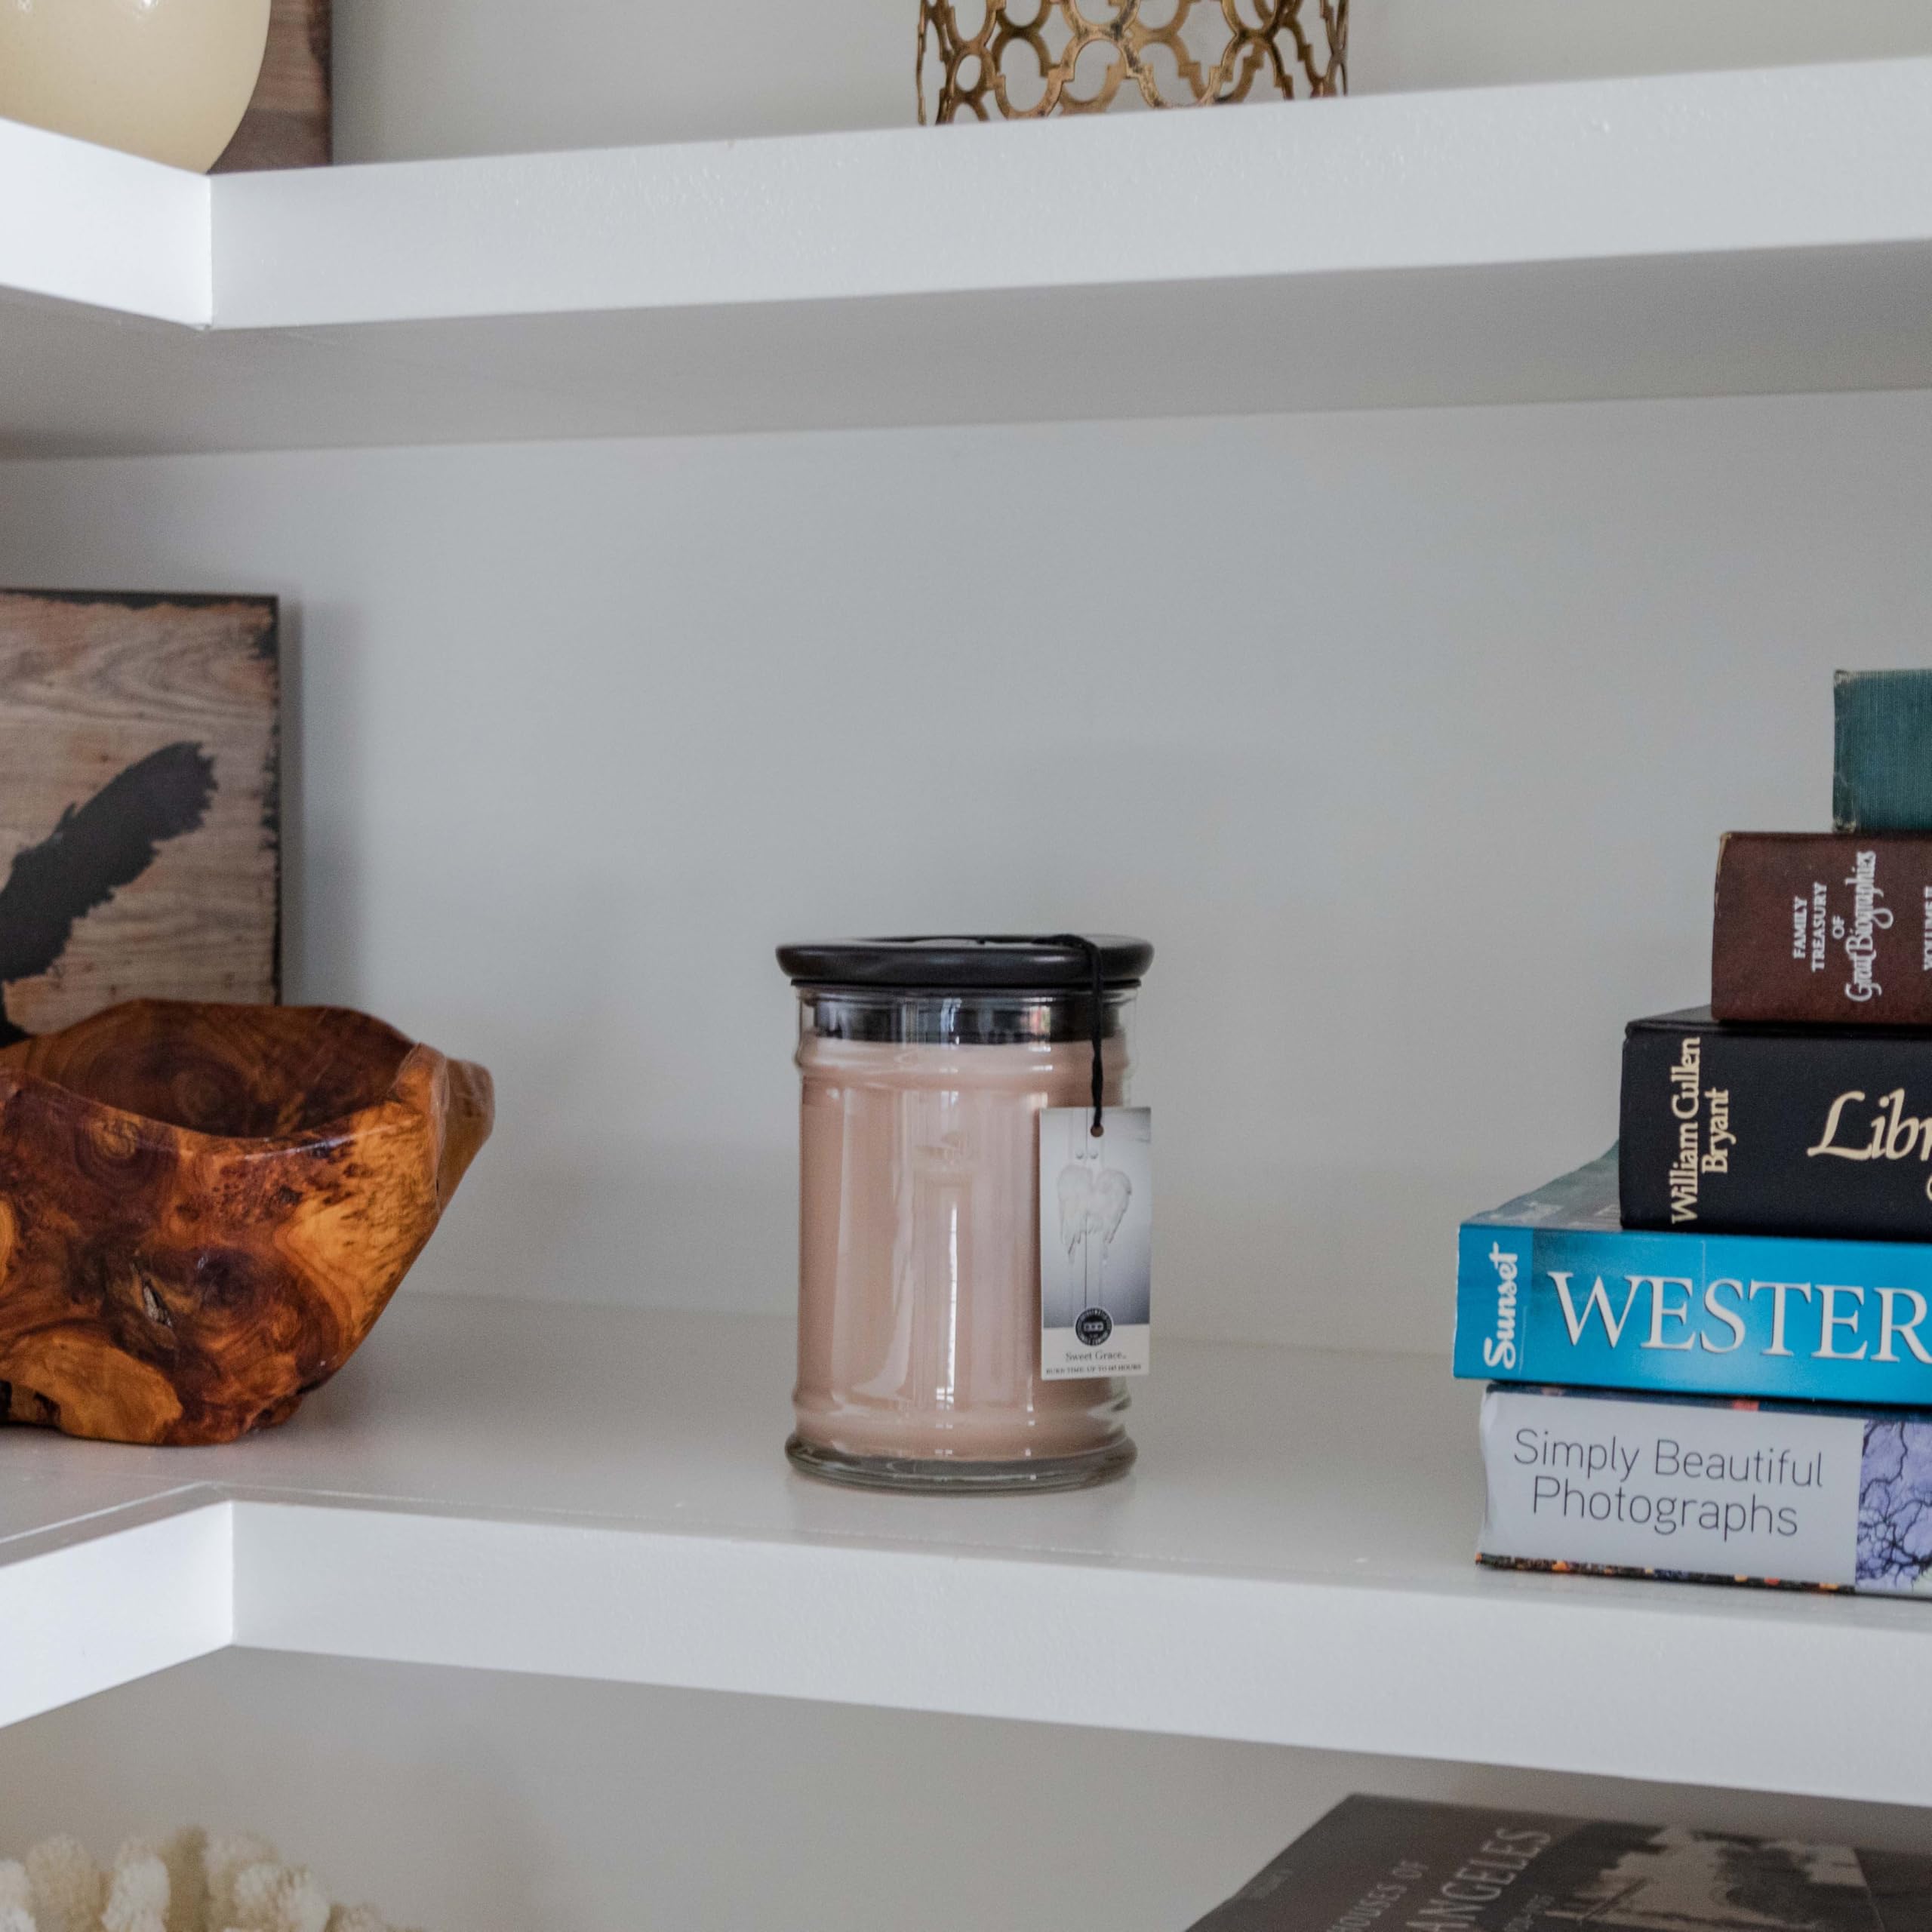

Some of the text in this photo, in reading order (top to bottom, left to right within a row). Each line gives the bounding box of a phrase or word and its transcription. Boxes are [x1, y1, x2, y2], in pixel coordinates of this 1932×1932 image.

[1792, 896, 1807, 959] FAMILY
[1811, 881, 1827, 973] TREASURY
[1832, 915, 1845, 940] OF
[1844, 850, 1894, 955] Biographies
[1669, 1036, 1700, 1224] William Cullen
[1701, 1087, 1737, 1174] Bryant
[1484, 1241, 1518, 1370] Sunset
[1547, 1271, 1932, 1364] WESTER
[1065, 1350, 1092, 1361] Sweet
[1514, 1428, 1823, 1487] Simply Beautiful
[1533, 1475, 1798, 1542] Photographs
